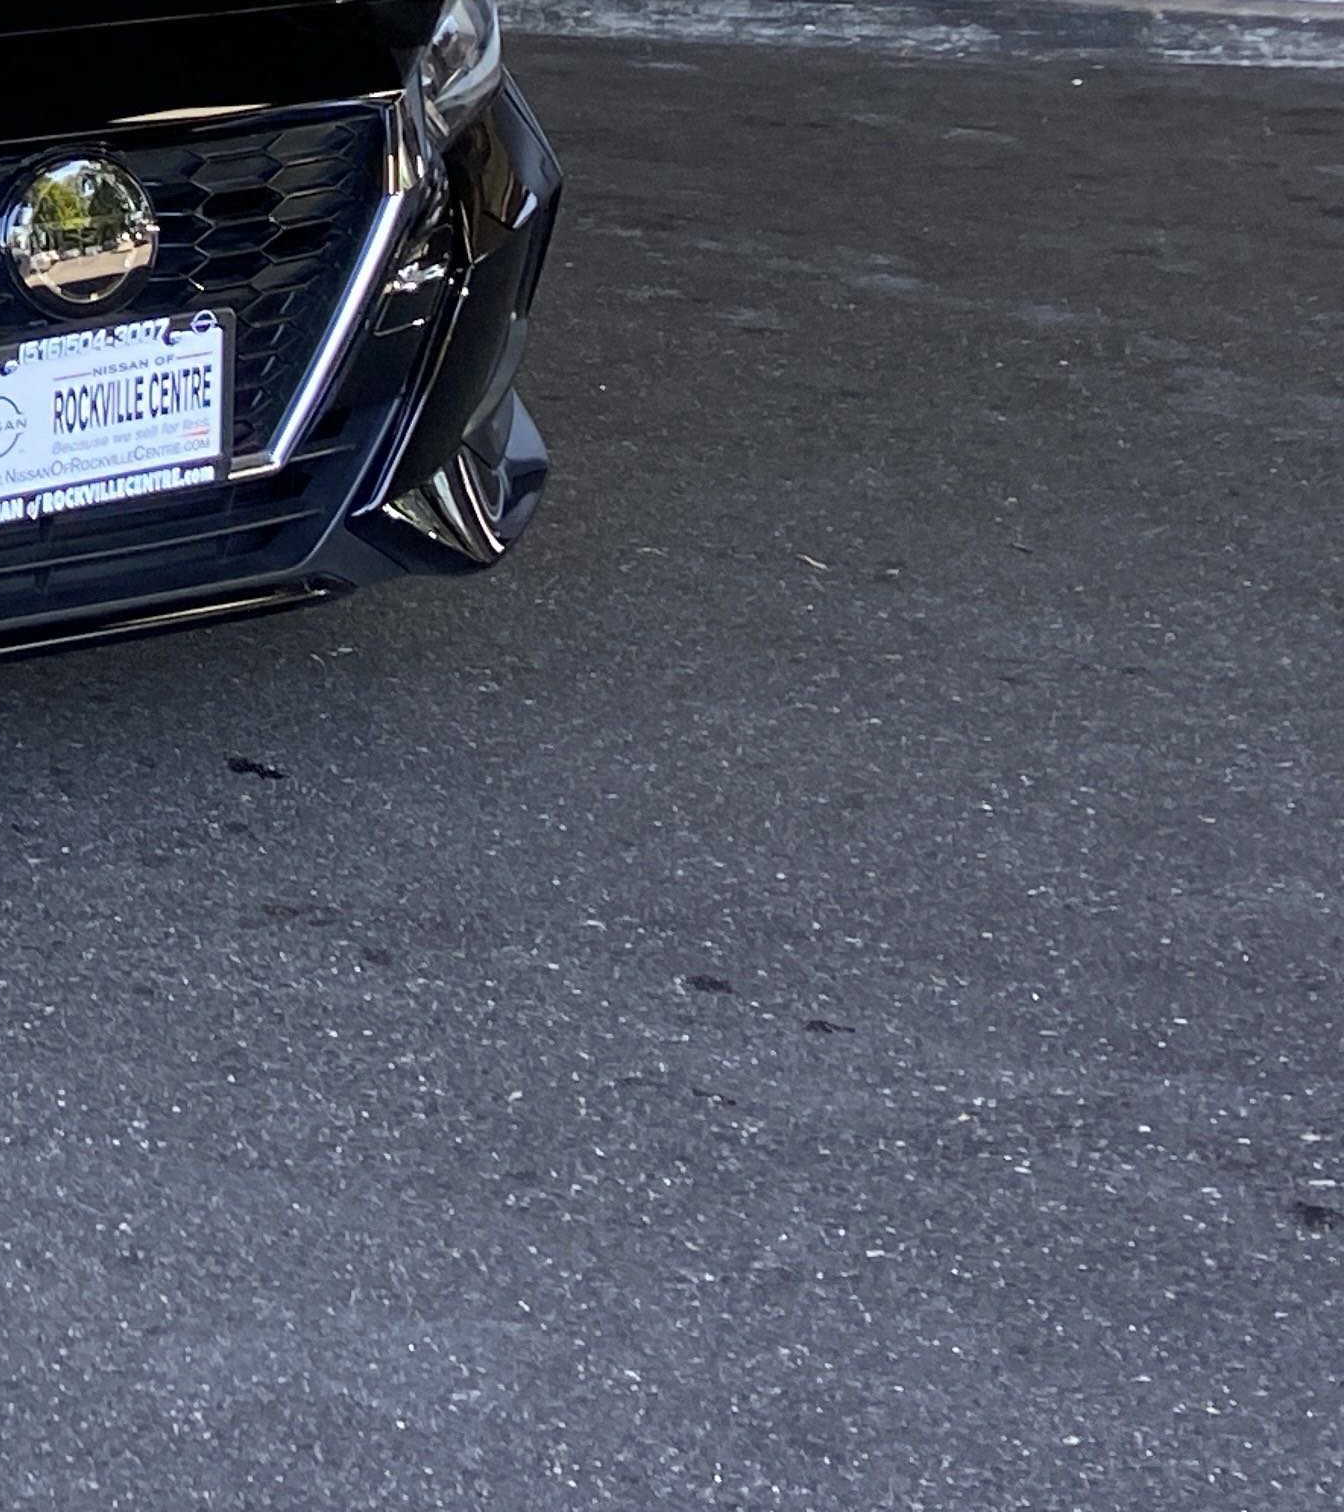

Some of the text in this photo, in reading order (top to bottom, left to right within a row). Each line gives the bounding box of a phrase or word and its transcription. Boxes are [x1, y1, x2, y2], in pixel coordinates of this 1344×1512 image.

[93, 354, 175, 376] NISSAN OF
[53, 364, 212, 436] ROCKVILLE CENTRE
[26, 494, 42, 520] of
